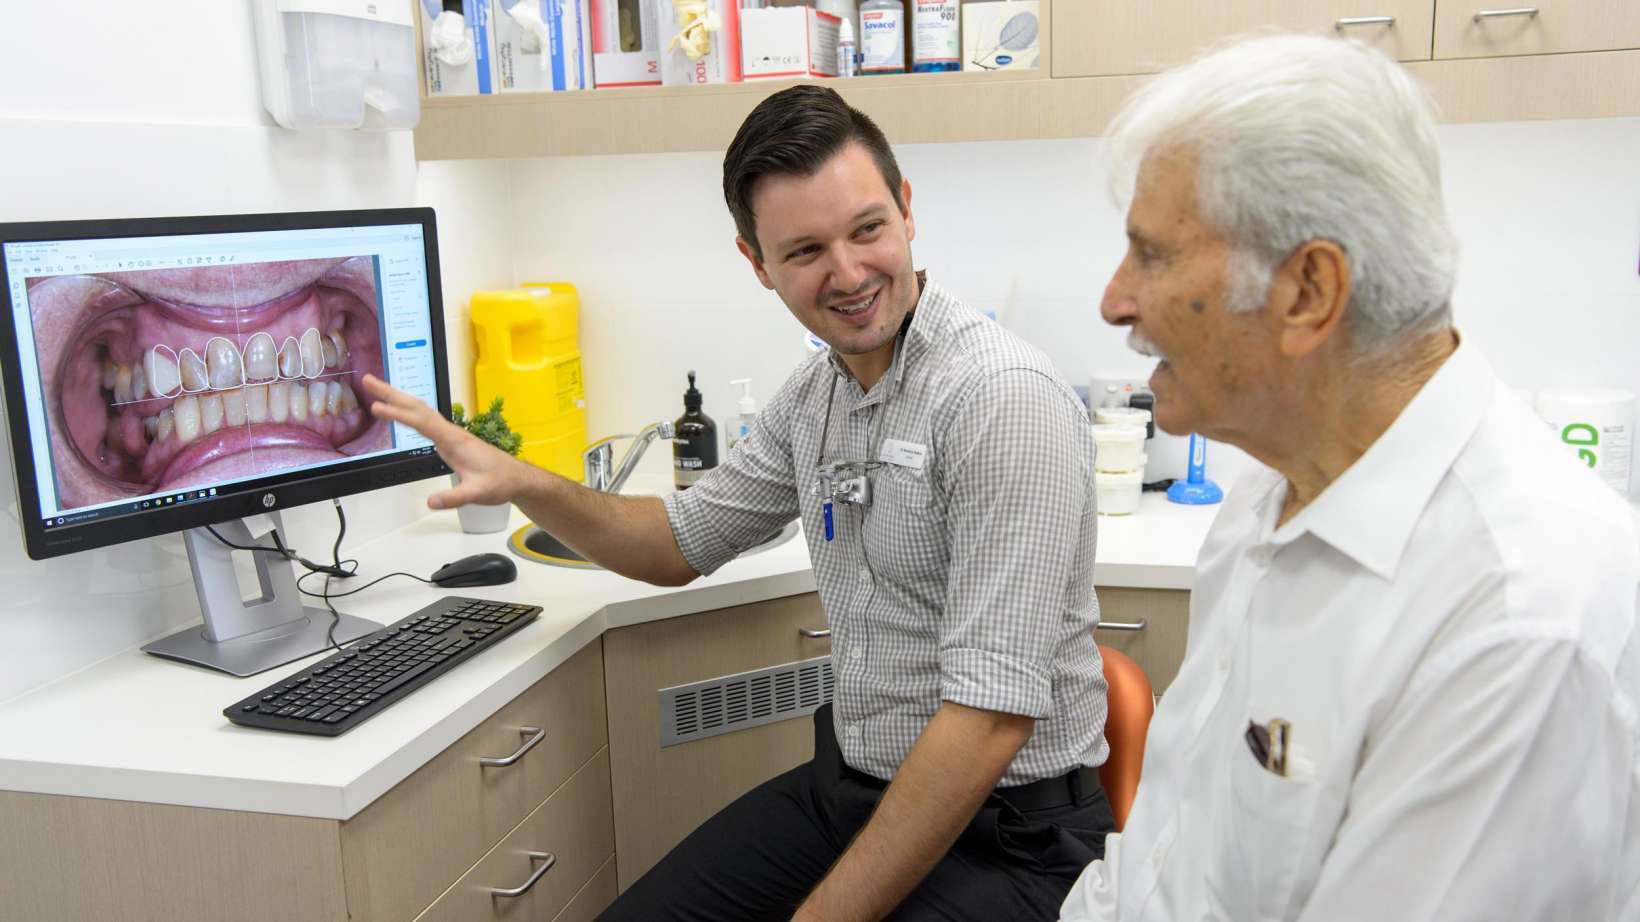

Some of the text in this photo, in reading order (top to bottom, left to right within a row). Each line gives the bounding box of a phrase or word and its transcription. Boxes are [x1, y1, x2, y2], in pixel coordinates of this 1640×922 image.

[863, 20, 896, 30] Savacol
[647, 60, 658, 73] M
[695, 60, 706, 84] 100
